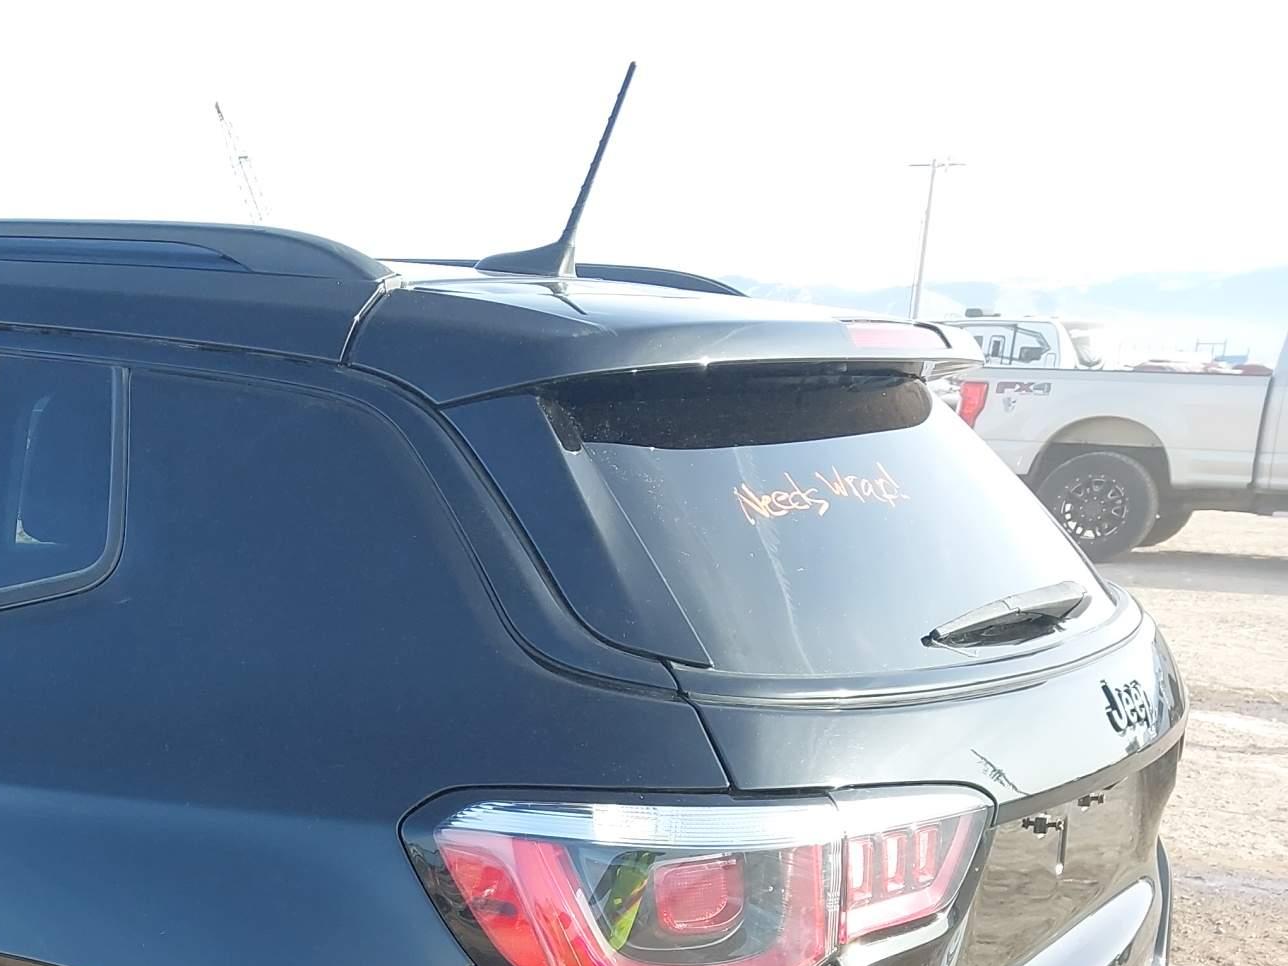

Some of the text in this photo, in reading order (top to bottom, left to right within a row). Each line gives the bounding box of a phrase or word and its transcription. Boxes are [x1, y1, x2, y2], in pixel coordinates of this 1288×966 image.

[995, 380, 1053, 395] FX4
[732, 471, 831, 526] Needs
[1099, 679, 1158, 736] Jeep
